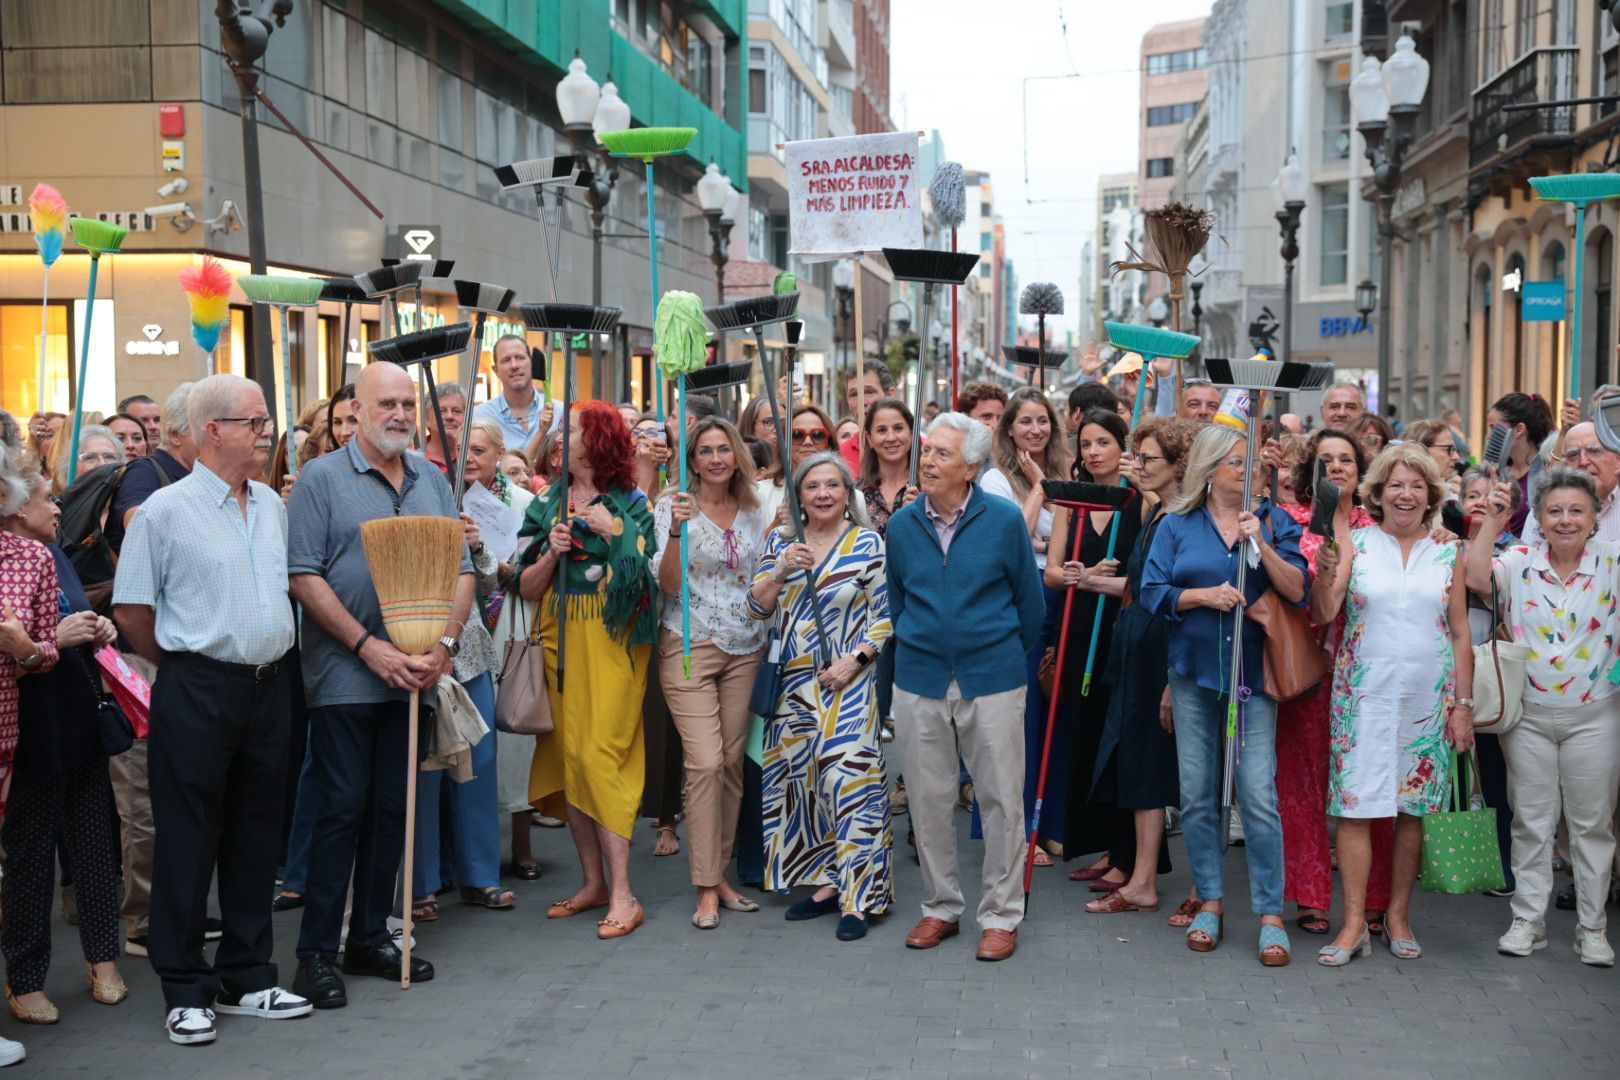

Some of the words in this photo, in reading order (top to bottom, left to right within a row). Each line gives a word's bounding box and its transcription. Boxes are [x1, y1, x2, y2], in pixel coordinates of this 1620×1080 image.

[801, 160, 833, 176] SRA.
[834, 153, 914, 173] ALCALDESA:
[809, 176, 855, 193] MENOS
[858, 174, 896, 190] RUIDO
[899, 174, 909, 189] Y
[840, 190, 910, 211] LIMPIEZA.
